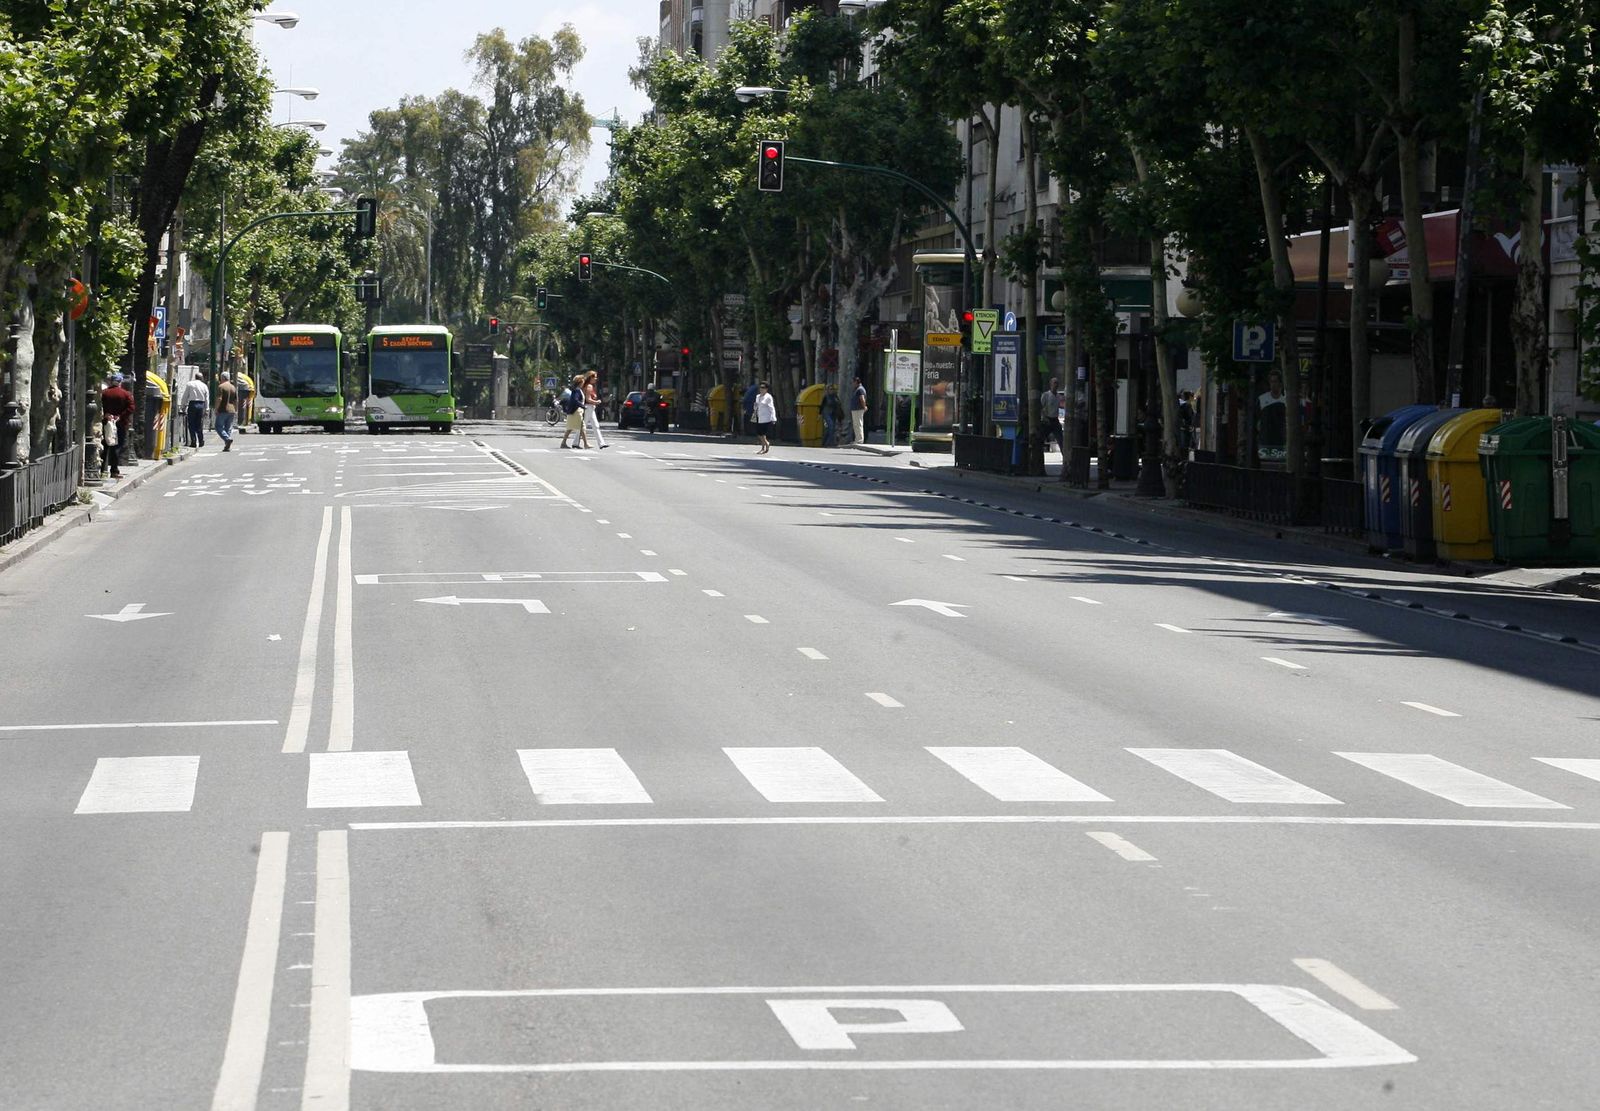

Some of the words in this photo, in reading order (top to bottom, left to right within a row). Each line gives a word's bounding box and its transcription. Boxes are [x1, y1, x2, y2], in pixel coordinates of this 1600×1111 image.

[1241, 324, 1267, 357] P
[162, 489, 325, 497] TAXI
[765, 999, 965, 1050] P
